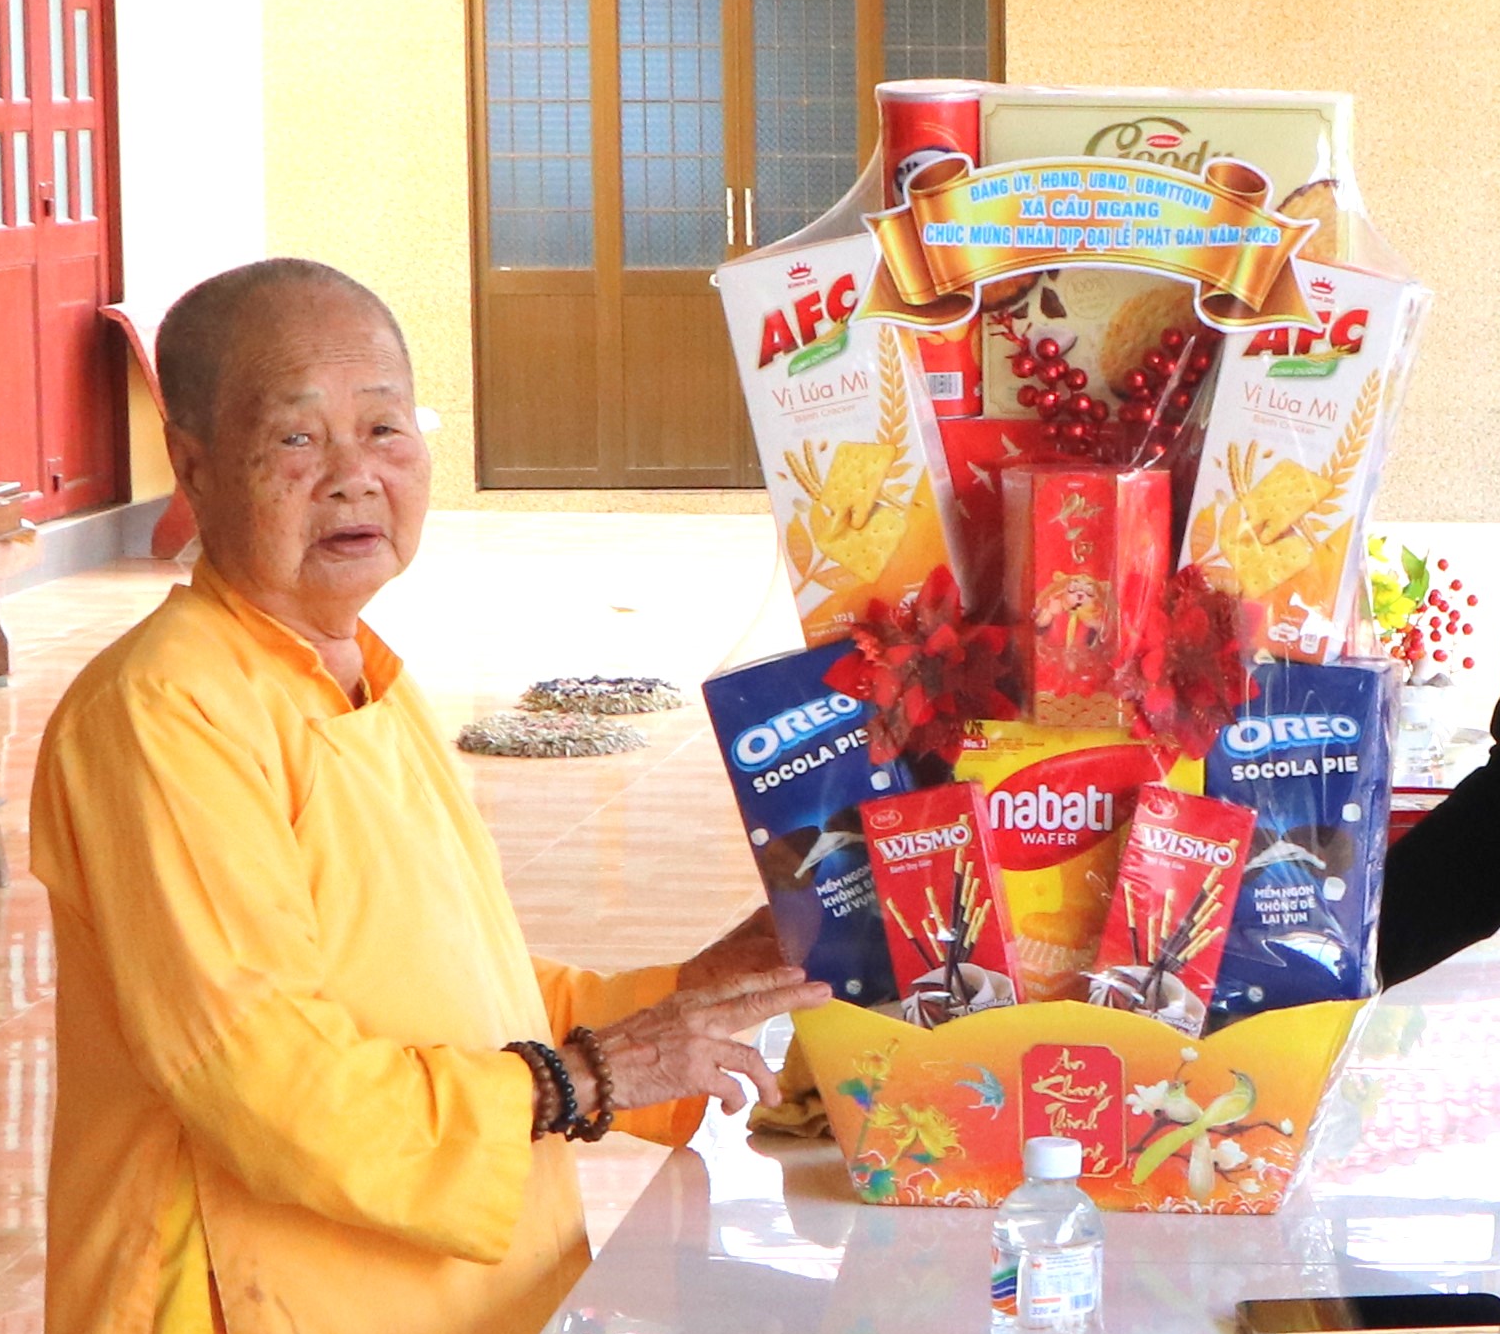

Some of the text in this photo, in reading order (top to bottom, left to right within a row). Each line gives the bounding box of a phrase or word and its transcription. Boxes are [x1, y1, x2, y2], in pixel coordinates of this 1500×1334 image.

[1021, 196, 1045, 216] XÃ
[1096, 201, 1160, 217] NGANG
[1136, 176, 1213, 212] UBMTTQVN
[925, 221, 964, 244] CHÚC
[970, 222, 1011, 245] MỪNG
[1016, 221, 1054, 245] NHÂN
[1059, 228, 1083, 251] DỊP
[1087, 228, 1110, 251] ĐẠI
[1114, 221, 1132, 246] LỄ
[1136, 224, 1171, 250] PHẬT
[1244, 228, 1280, 244] 2026
[758, 273, 858, 369] AFC
[772, 371, 868, 410] Vị Lúa Mì
[1244, 382, 1338, 422] Vị Lúa Mì
[735, 692, 860, 768] OREO
[1226, 716, 1358, 753] OREO
[752, 728, 870, 794] SOCOLA PIE
[1231, 755, 1359, 781] SOCOLA PIE
[989, 783, 1114, 831] nabati
[877, 825, 969, 860] WISMO
[1020, 832, 1077, 845] WAFER
[1143, 826, 1233, 866] WISMO
[821, 884, 863, 909] KHÔNG
[1255, 899, 1298, 912] KHÔNG
[1281, 885, 1315, 898] NGON
